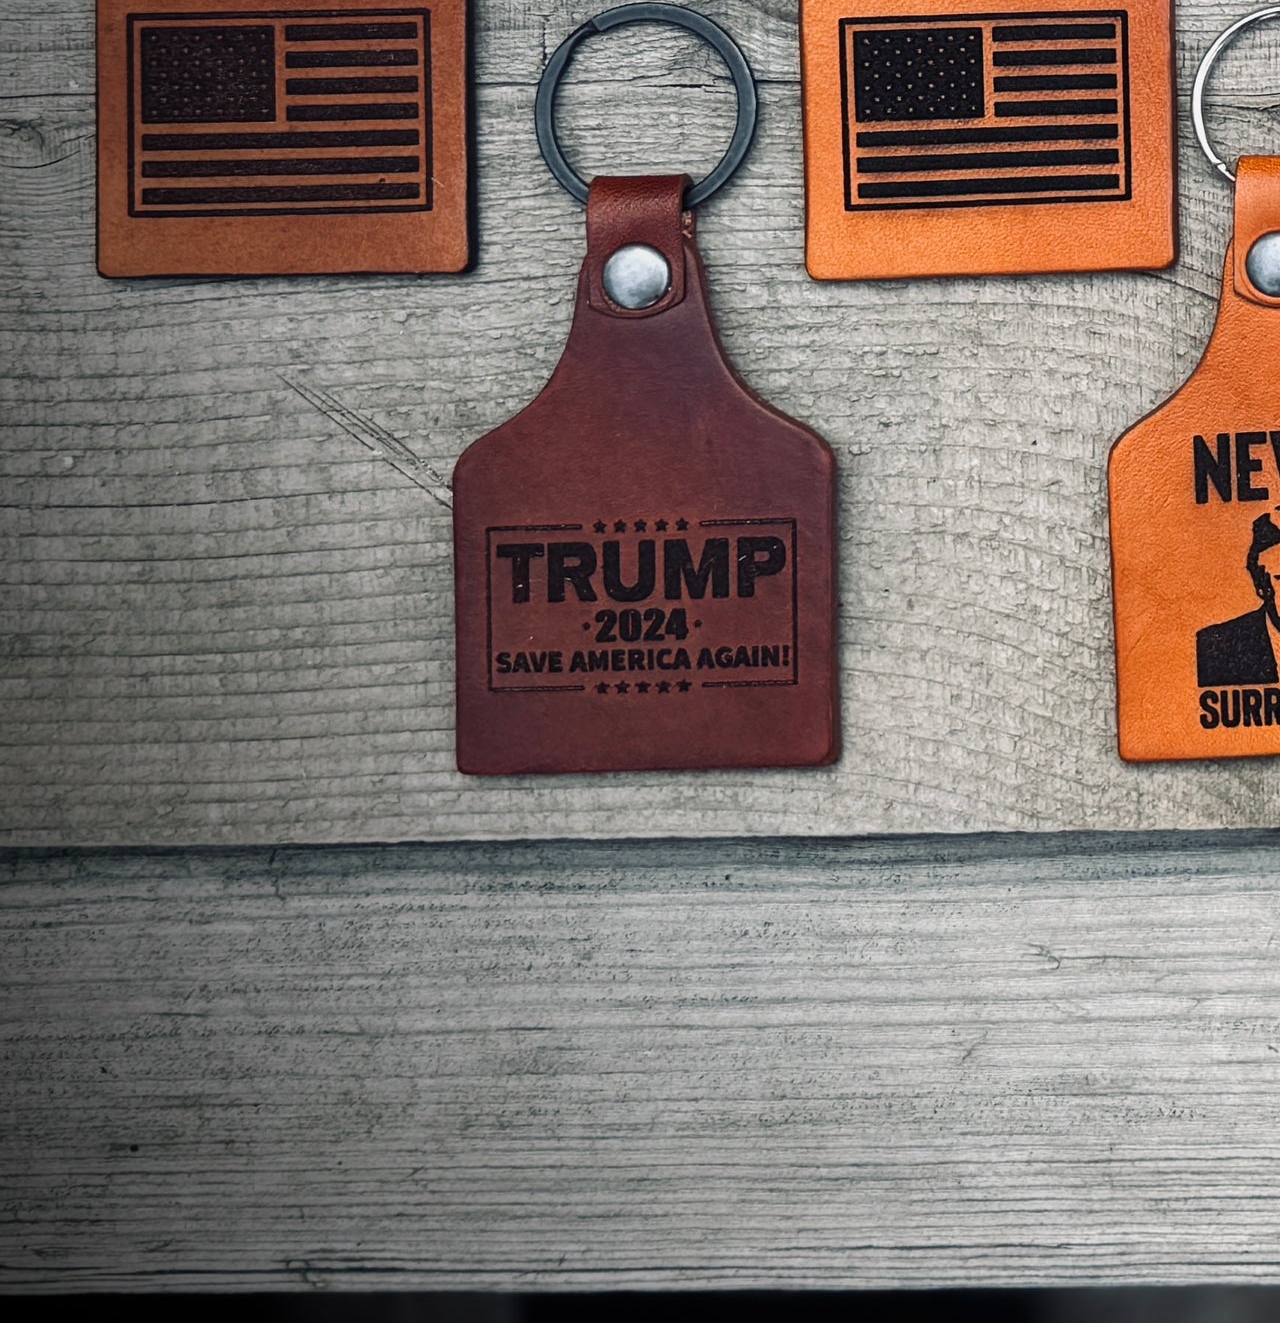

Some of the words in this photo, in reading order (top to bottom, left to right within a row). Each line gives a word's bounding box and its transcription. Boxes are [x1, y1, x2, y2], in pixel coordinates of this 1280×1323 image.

[496, 536, 786, 603] TRUMP
[495, 650, 563, 674] SAVE
[569, 648, 692, 673] AMERICA
[697, 644, 790, 669] AGAIN!
